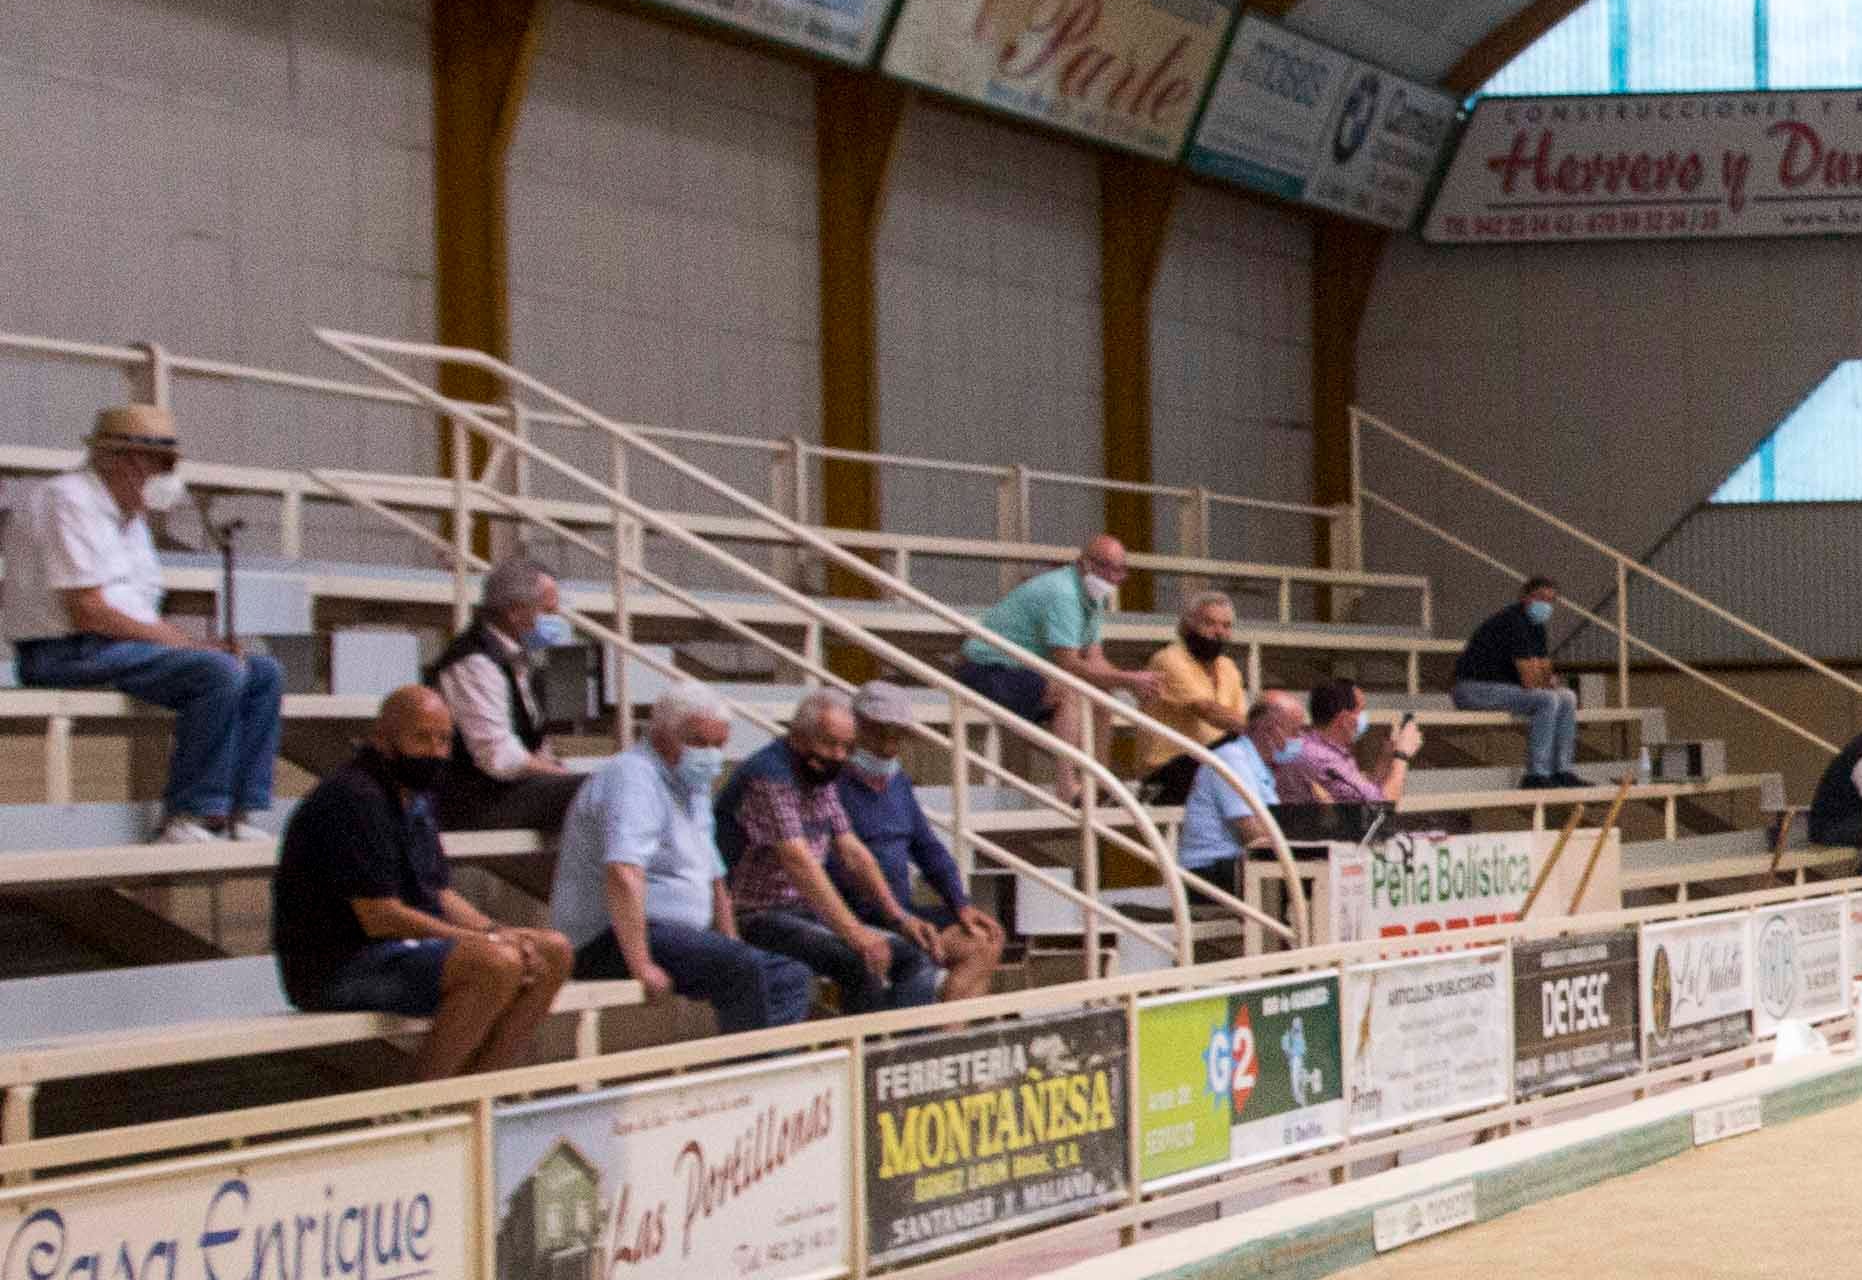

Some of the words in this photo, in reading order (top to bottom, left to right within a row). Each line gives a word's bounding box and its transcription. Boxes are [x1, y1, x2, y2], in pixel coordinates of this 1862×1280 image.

[1504, 98, 1797, 123] CONSTRUCCIONES
[1487, 128, 1705, 196] Herrero
[1721, 147, 1751, 214] y
[1437, 842, 1533, 902] Bolística
[876, 1041, 1027, 1101] FERRETERIA
[1206, 1026, 1257, 1093] G2
[876, 1067, 1116, 1180] MONTAÑESA
